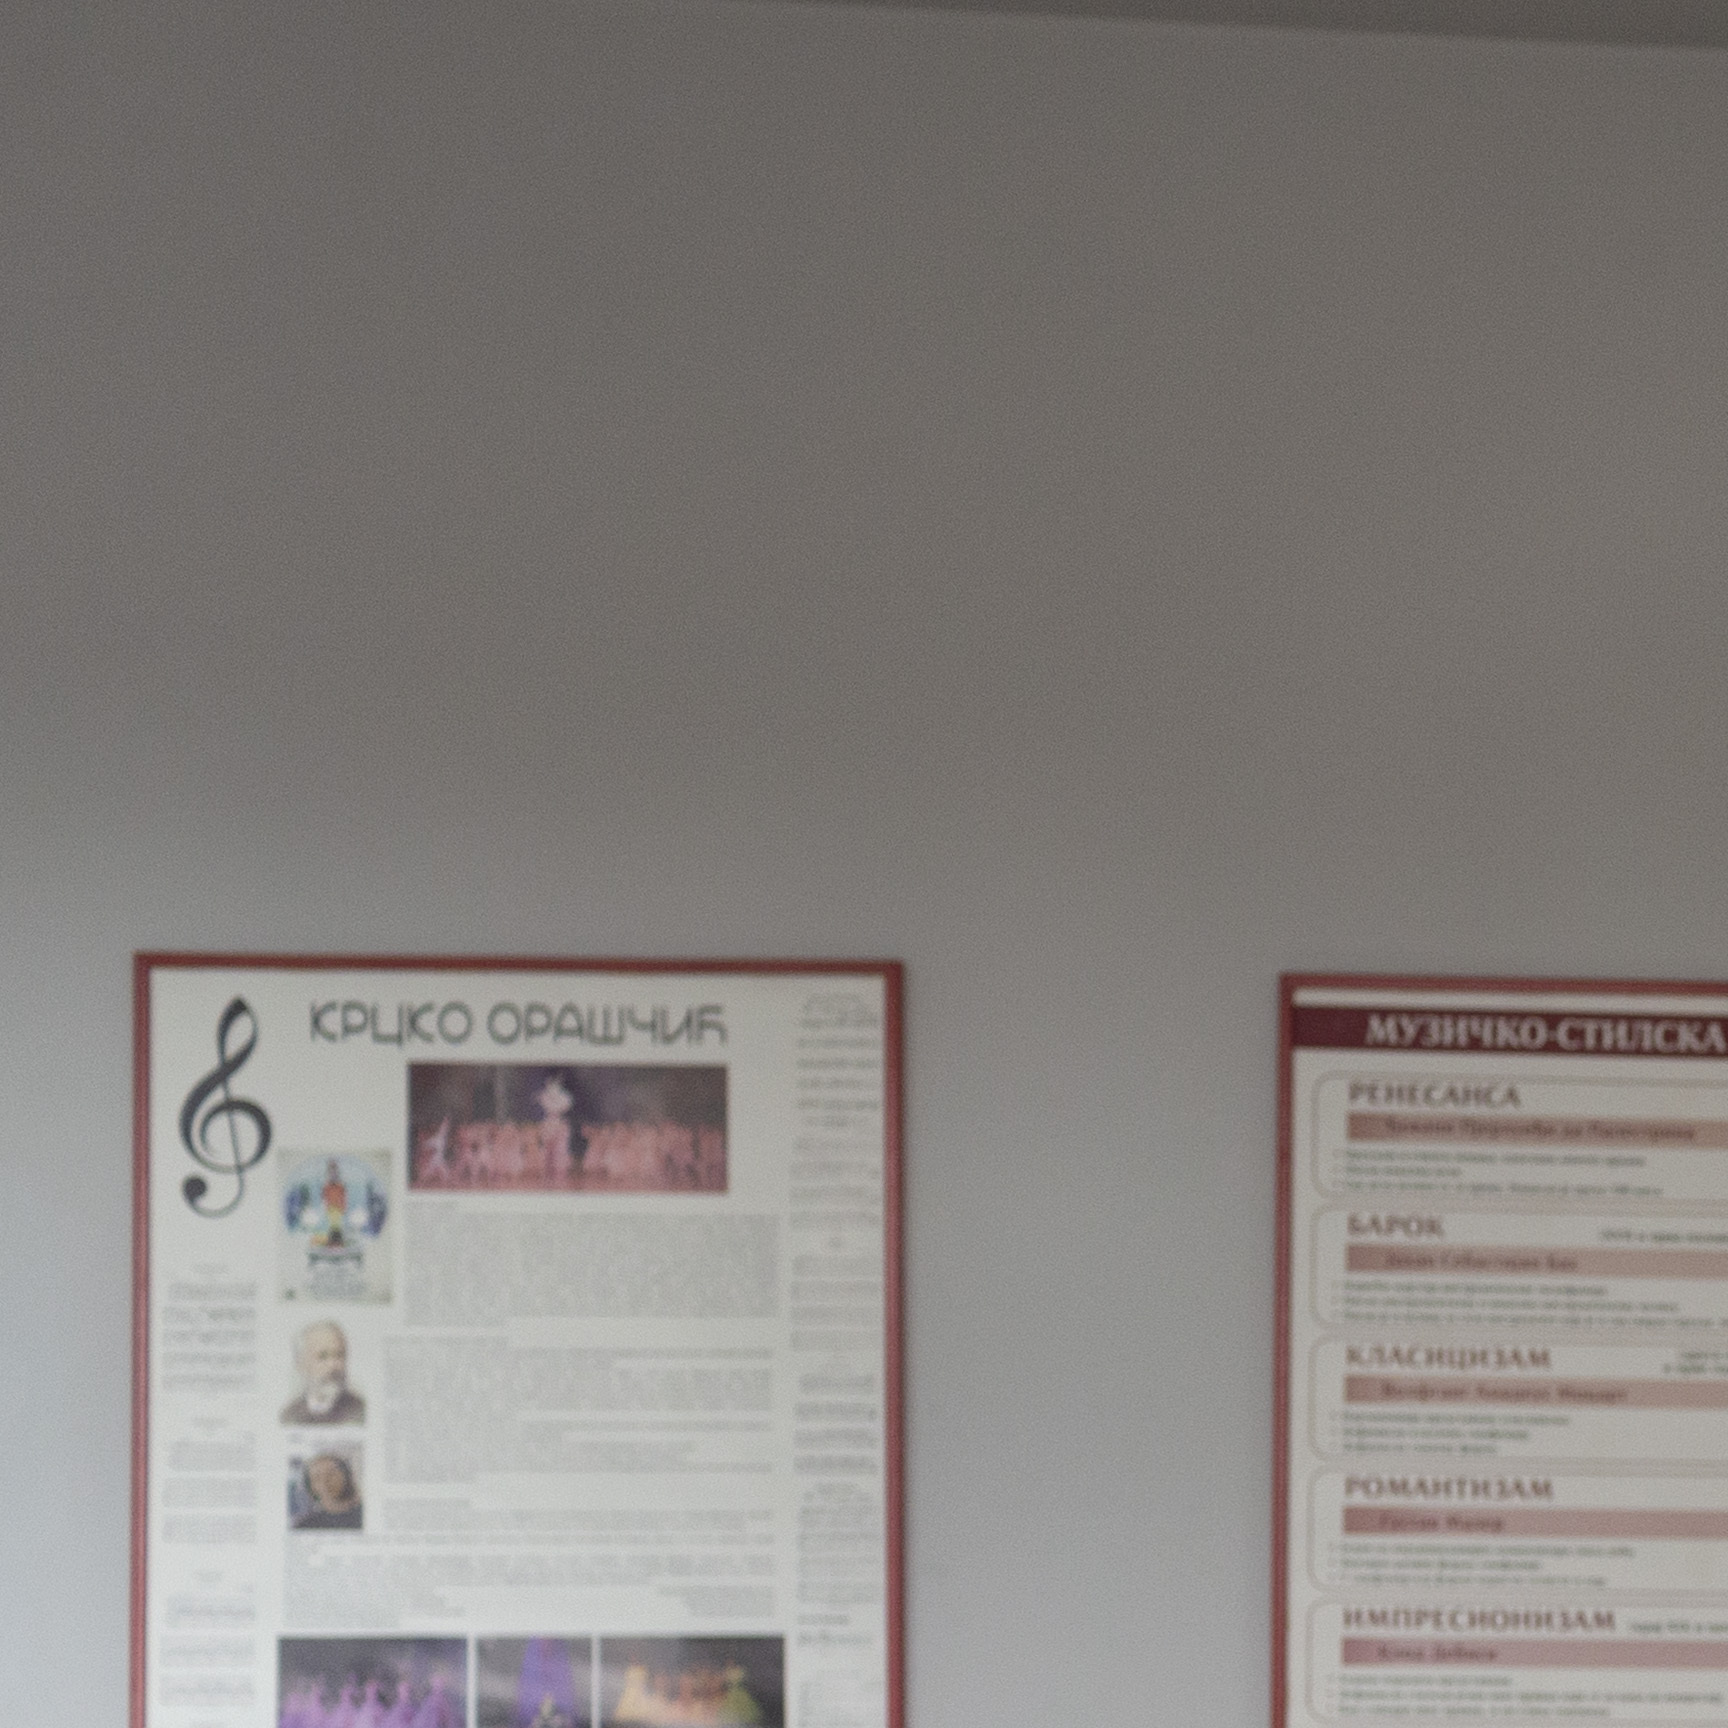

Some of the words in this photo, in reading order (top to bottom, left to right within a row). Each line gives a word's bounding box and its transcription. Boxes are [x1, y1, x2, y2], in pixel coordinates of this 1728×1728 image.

[309, 1001, 471, 1051] КРЦКО
[487, 1002, 727, 1047] ОРАШЧИЋ
[1365, 1014, 1727, 1055] МУЗИЧКО-СТИЛСКА
[1349, 1080, 1521, 1109] РЕНЕСАНСА
[1347, 1213, 1444, 1239] БАРОК
[1345, 1344, 1551, 1372] КЛАСИЦИЗАМ
[1343, 1476, 1554, 1502] РОМАНТИЗАМ
[1342, 1606, 1616, 1634] ИМПРЕСИОНИЗАМ
